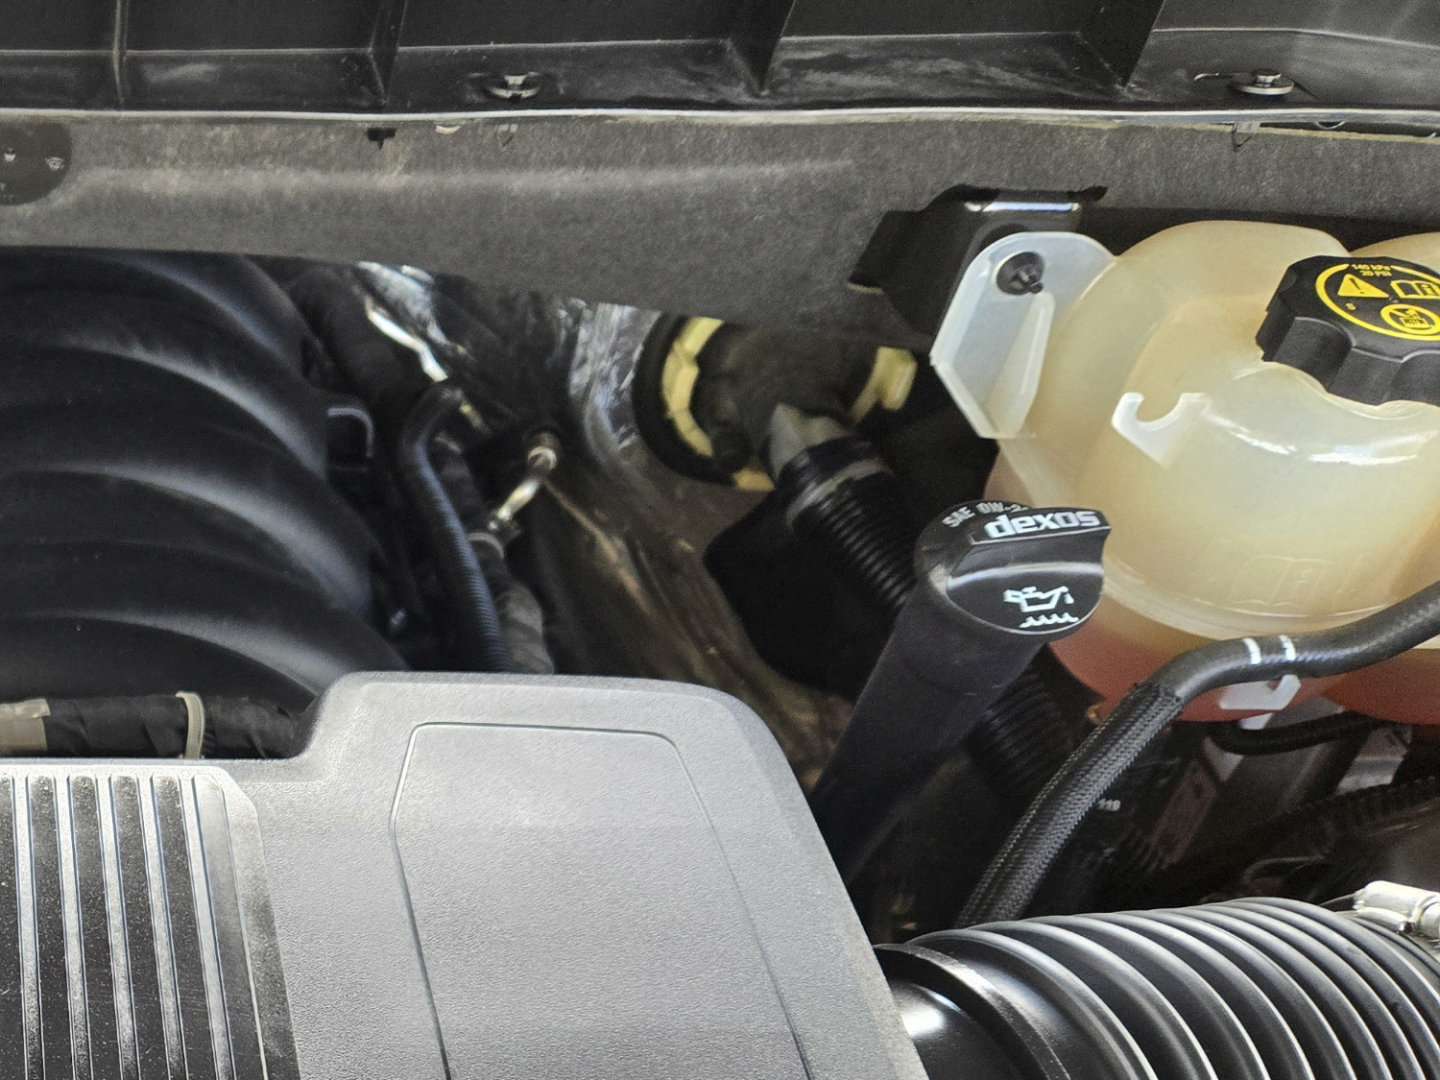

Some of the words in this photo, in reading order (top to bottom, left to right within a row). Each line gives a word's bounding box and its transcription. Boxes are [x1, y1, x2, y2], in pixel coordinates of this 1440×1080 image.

[942, 506, 976, 528] SAE
[976, 502, 1029, 514] 0W-2
[984, 511, 1101, 538] dexos
